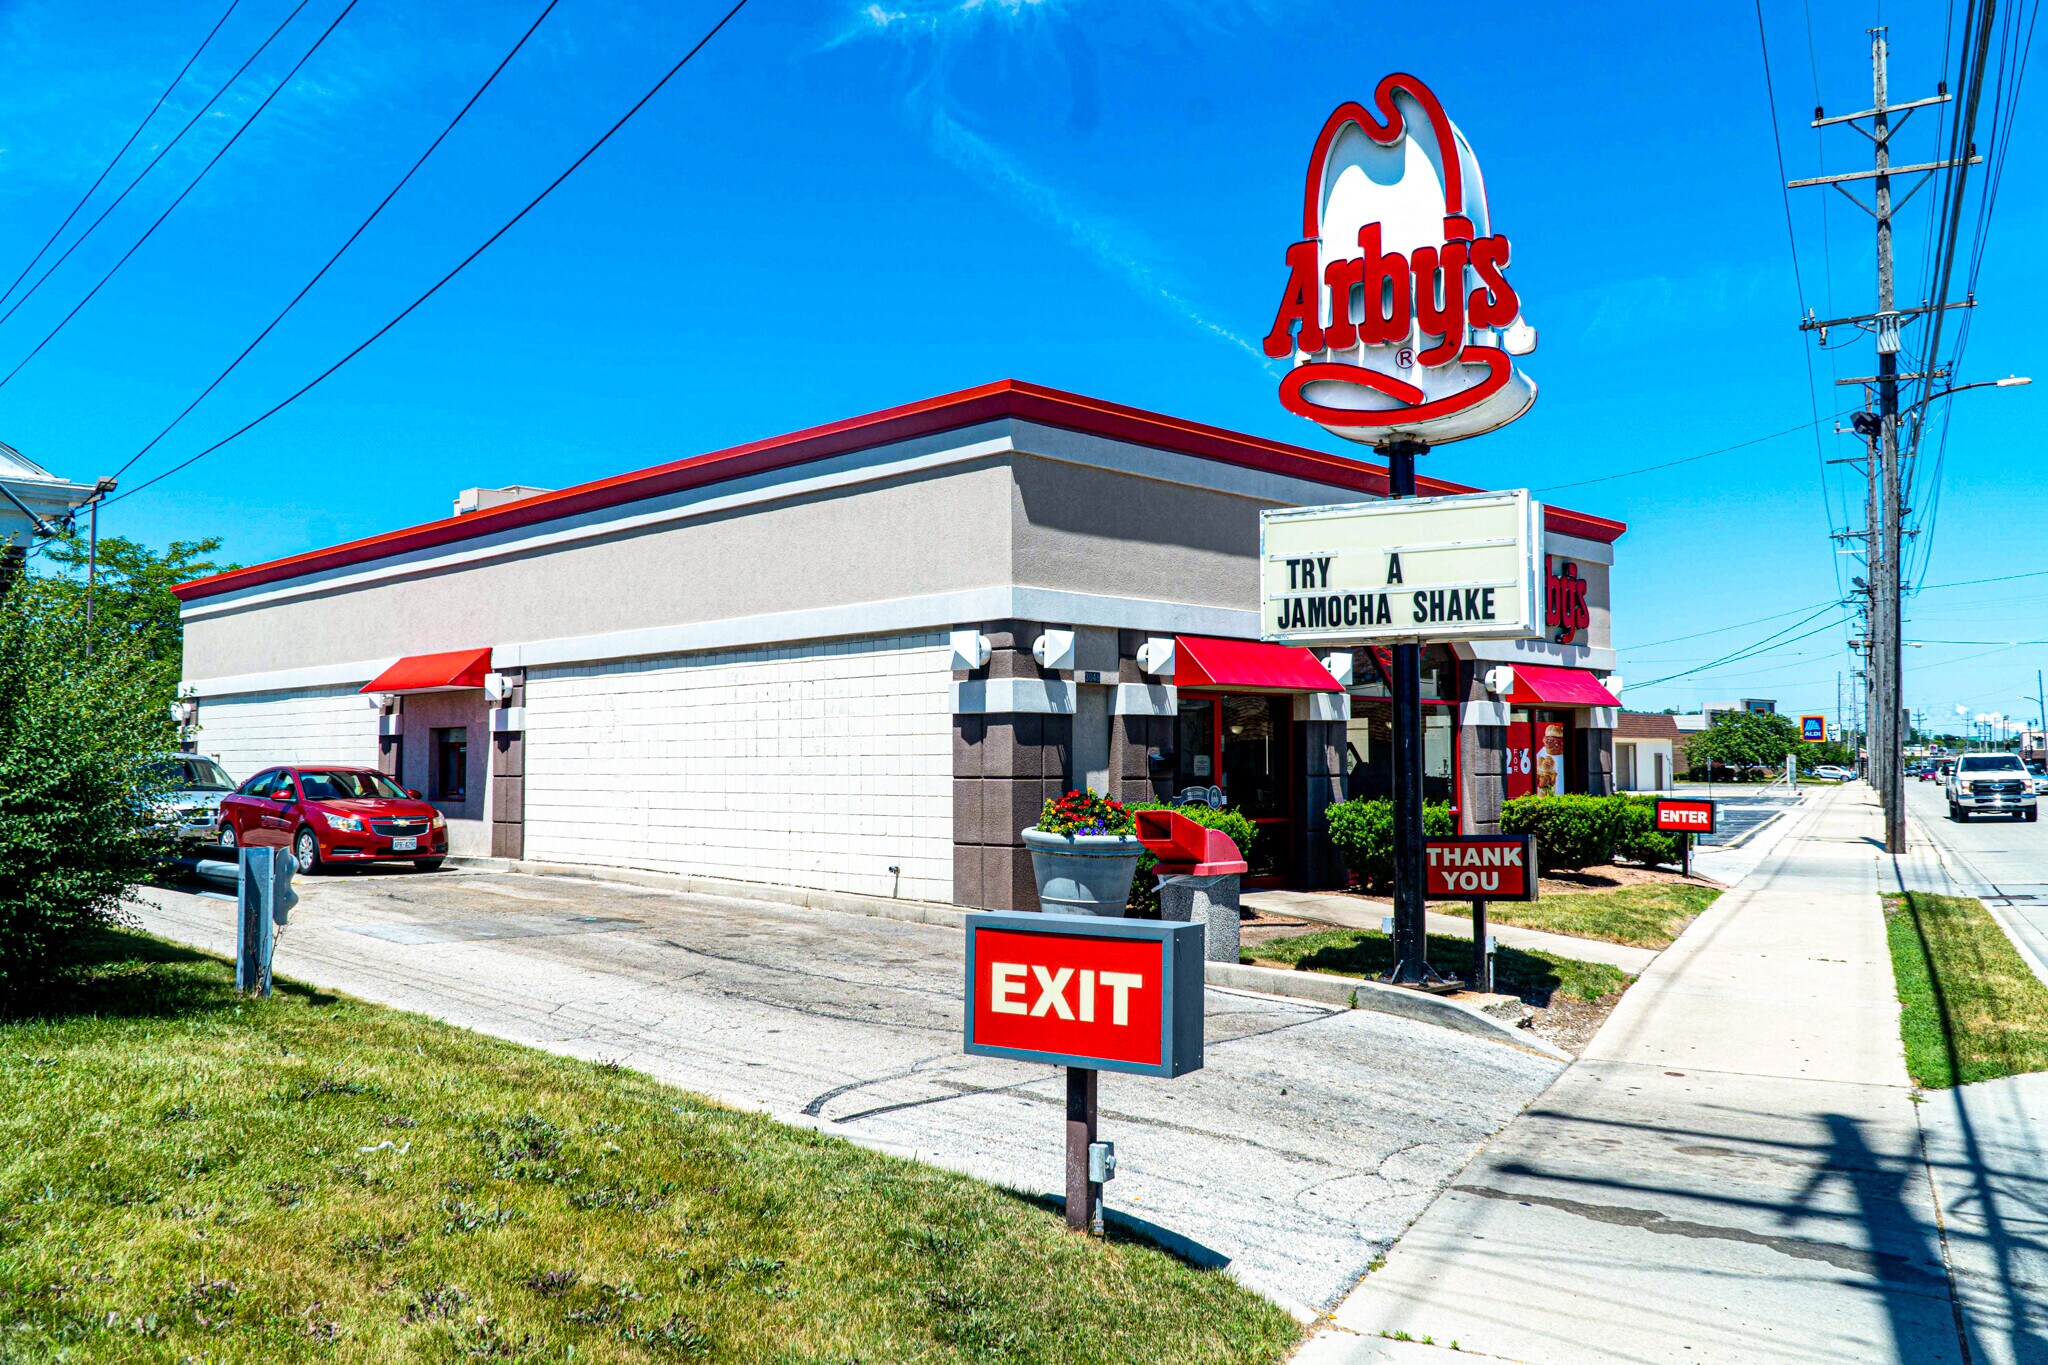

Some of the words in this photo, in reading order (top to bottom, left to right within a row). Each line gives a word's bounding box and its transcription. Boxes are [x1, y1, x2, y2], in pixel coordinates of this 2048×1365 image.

[1263, 216, 1521, 367] Arby's
[1286, 557, 1331, 589] TRY
[1387, 553, 1403, 584] A
[1277, 594, 1392, 629] JAMOCHA
[1413, 588, 1496, 623] SHAKE
[1545, 554, 1590, 644] by's
[1660, 809, 1708, 824] ENTER
[1426, 847, 1522, 866] THANK
[1441, 871, 1499, 891] YOU
[991, 961, 1143, 1026] EXIT
